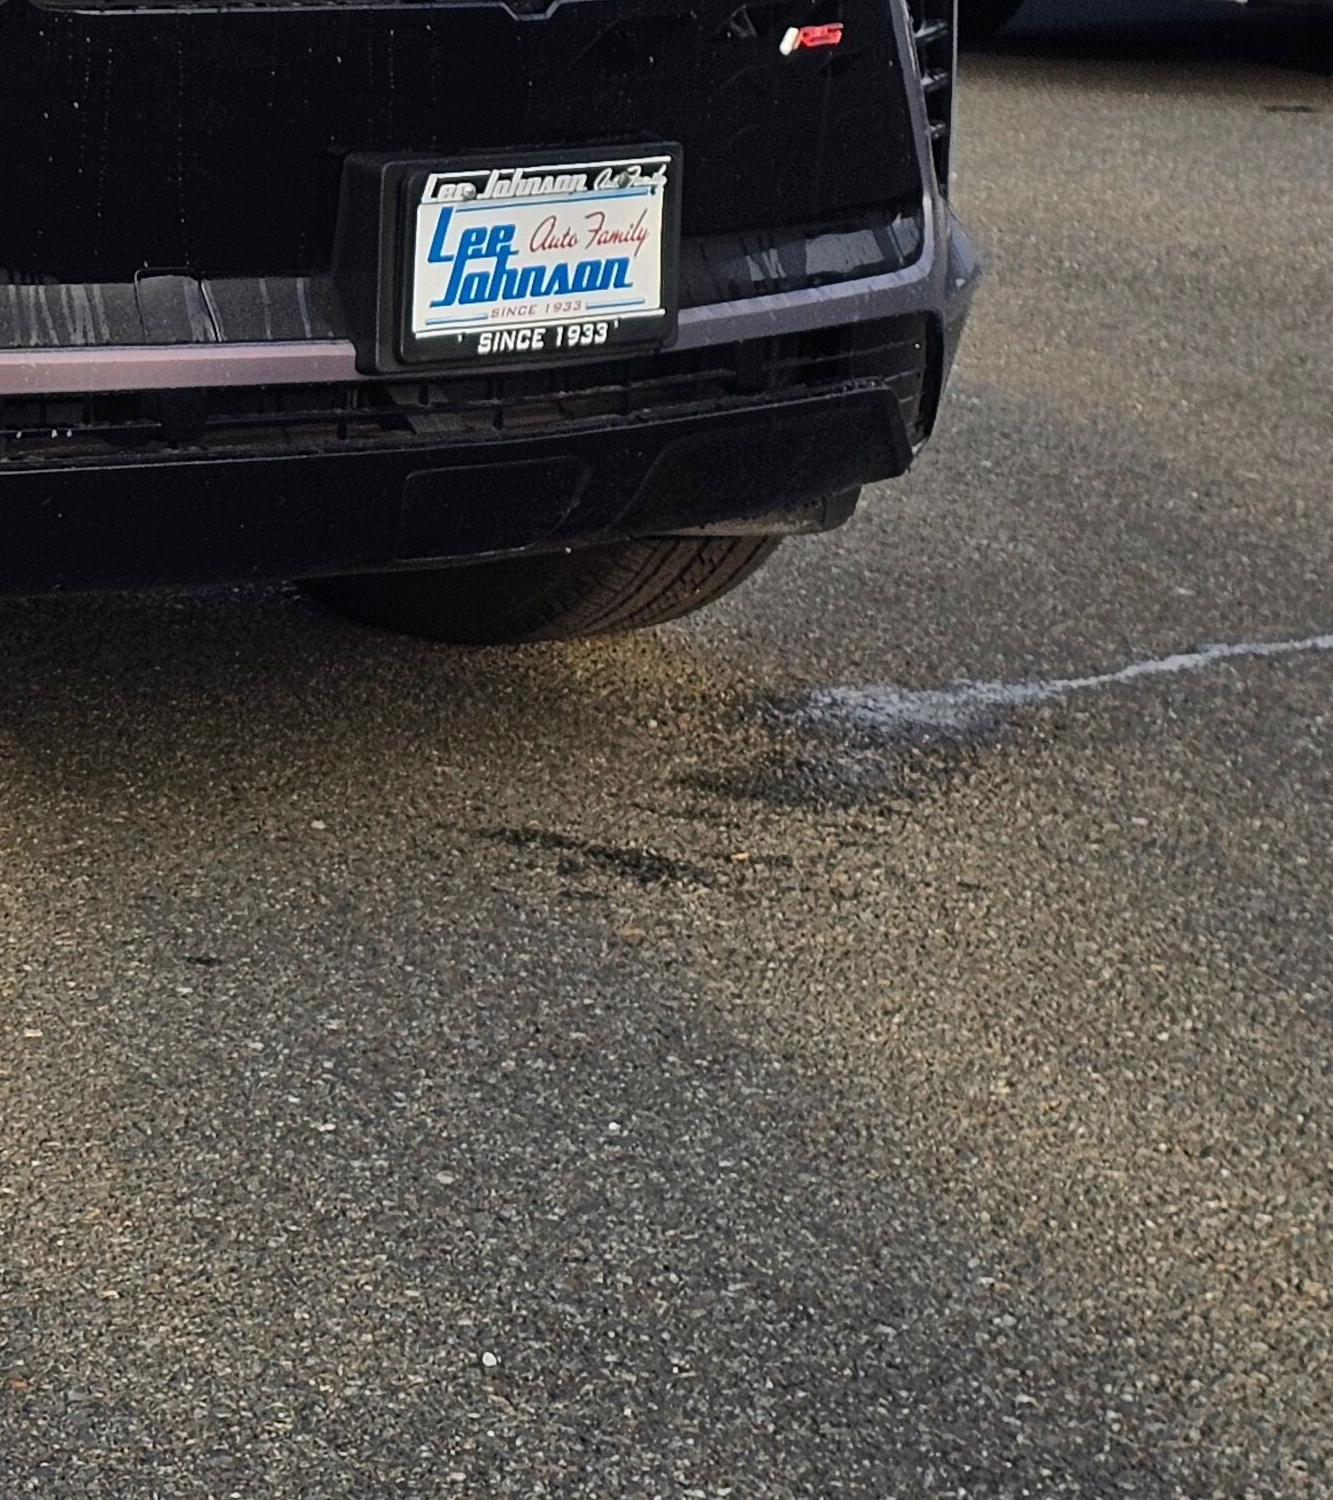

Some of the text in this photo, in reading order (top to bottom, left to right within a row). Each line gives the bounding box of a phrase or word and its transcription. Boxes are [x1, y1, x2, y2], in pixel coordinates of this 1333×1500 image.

[477, 168, 587, 200] Johnson
[428, 206, 519, 263] Lee
[529, 208, 650, 257] Auto Family
[429, 248, 633, 308] Johnson
[491, 300, 582, 319] SINCE 1933
[477, 322, 608, 354] SINCE 1933
